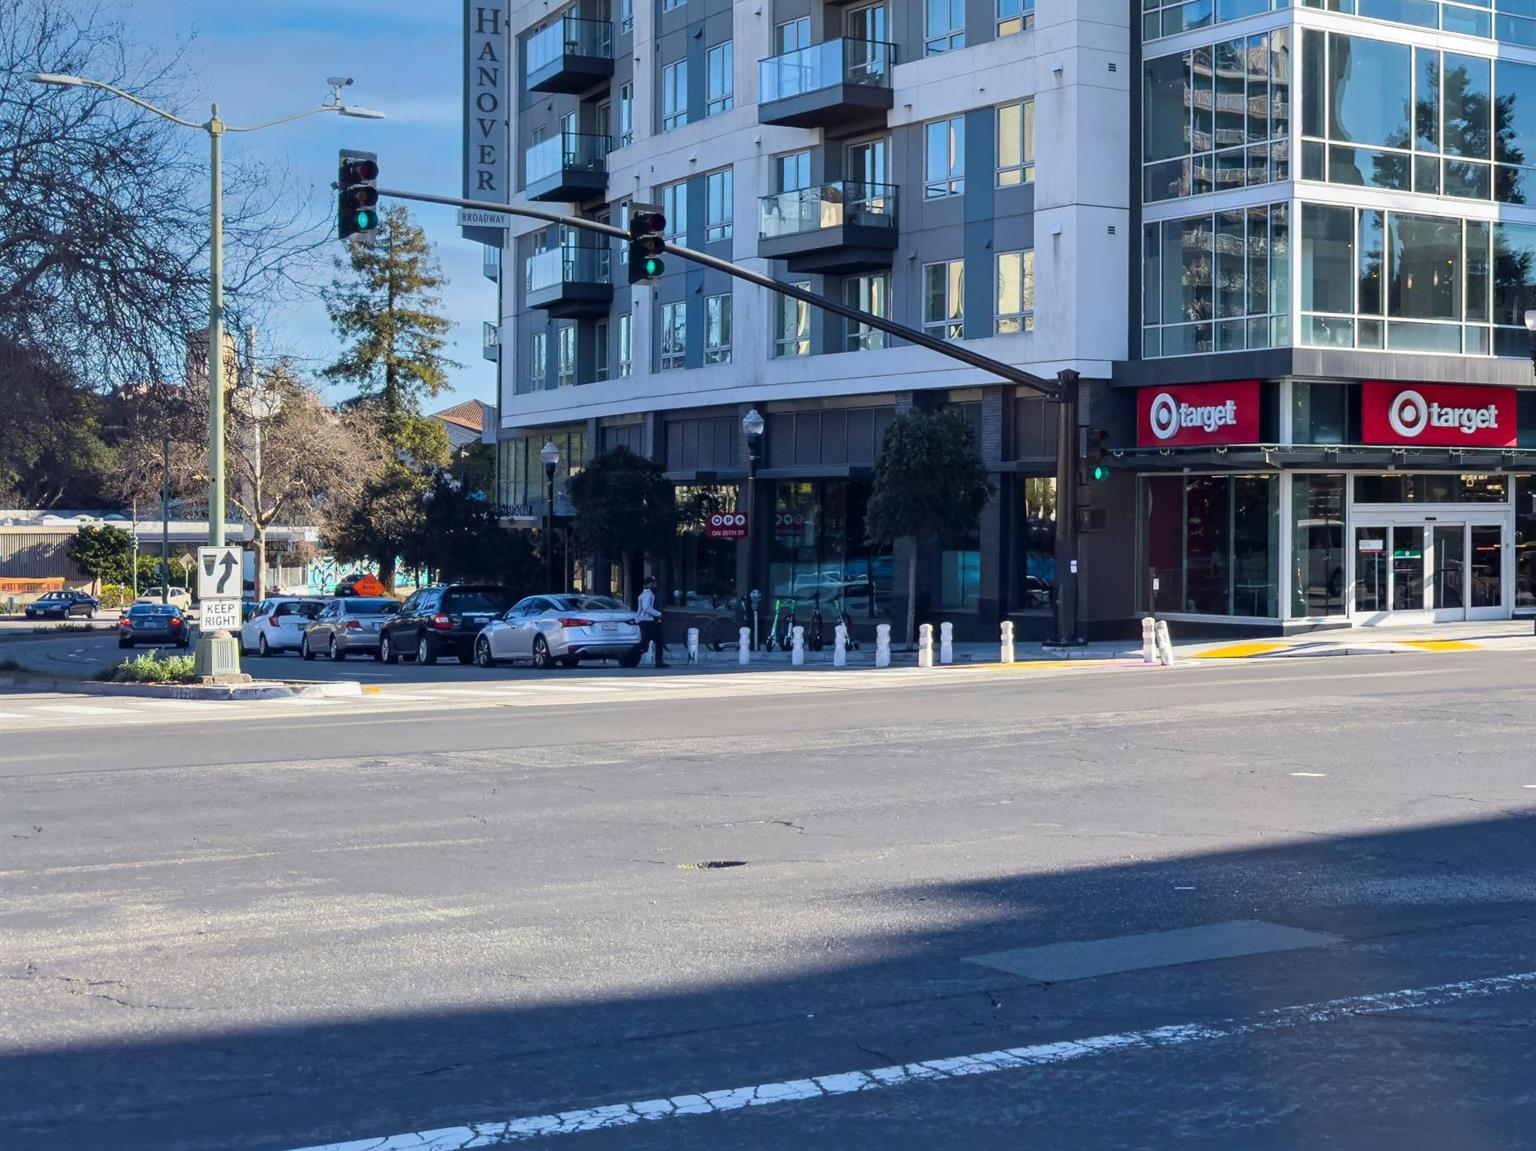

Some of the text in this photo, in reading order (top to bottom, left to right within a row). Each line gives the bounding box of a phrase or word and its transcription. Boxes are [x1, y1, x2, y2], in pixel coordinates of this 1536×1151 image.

[475, 7, 502, 191] HANOVER
[462, 212, 505, 224] BROADWAY
[1180, 400, 1236, 433] target
[1428, 402, 1498, 434] target
[207, 604, 235, 614] KEEP
[205, 616, 237, 626] RIGHT
